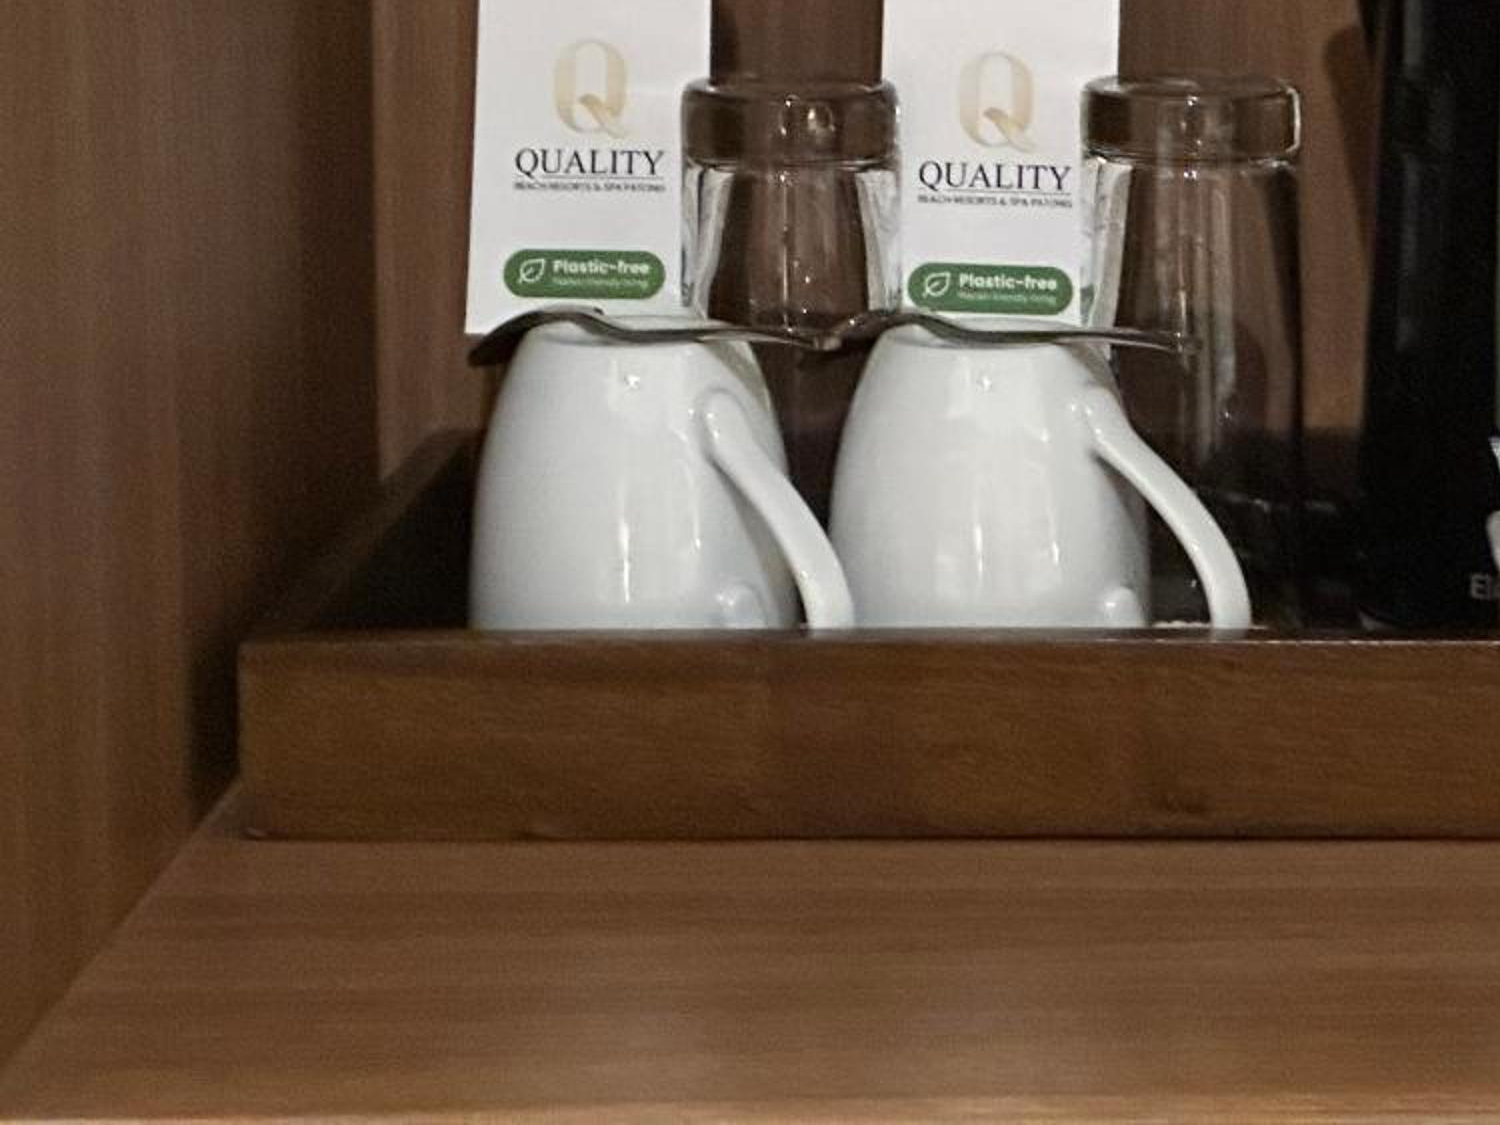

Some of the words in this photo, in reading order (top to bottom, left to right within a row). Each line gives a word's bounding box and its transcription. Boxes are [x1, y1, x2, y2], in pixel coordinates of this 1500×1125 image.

[514, 147, 665, 180] QUALITY
[918, 160, 1072, 192] QUALITY
[551, 258, 651, 274] Plastic-free
[958, 272, 1058, 291] Plastic-free
